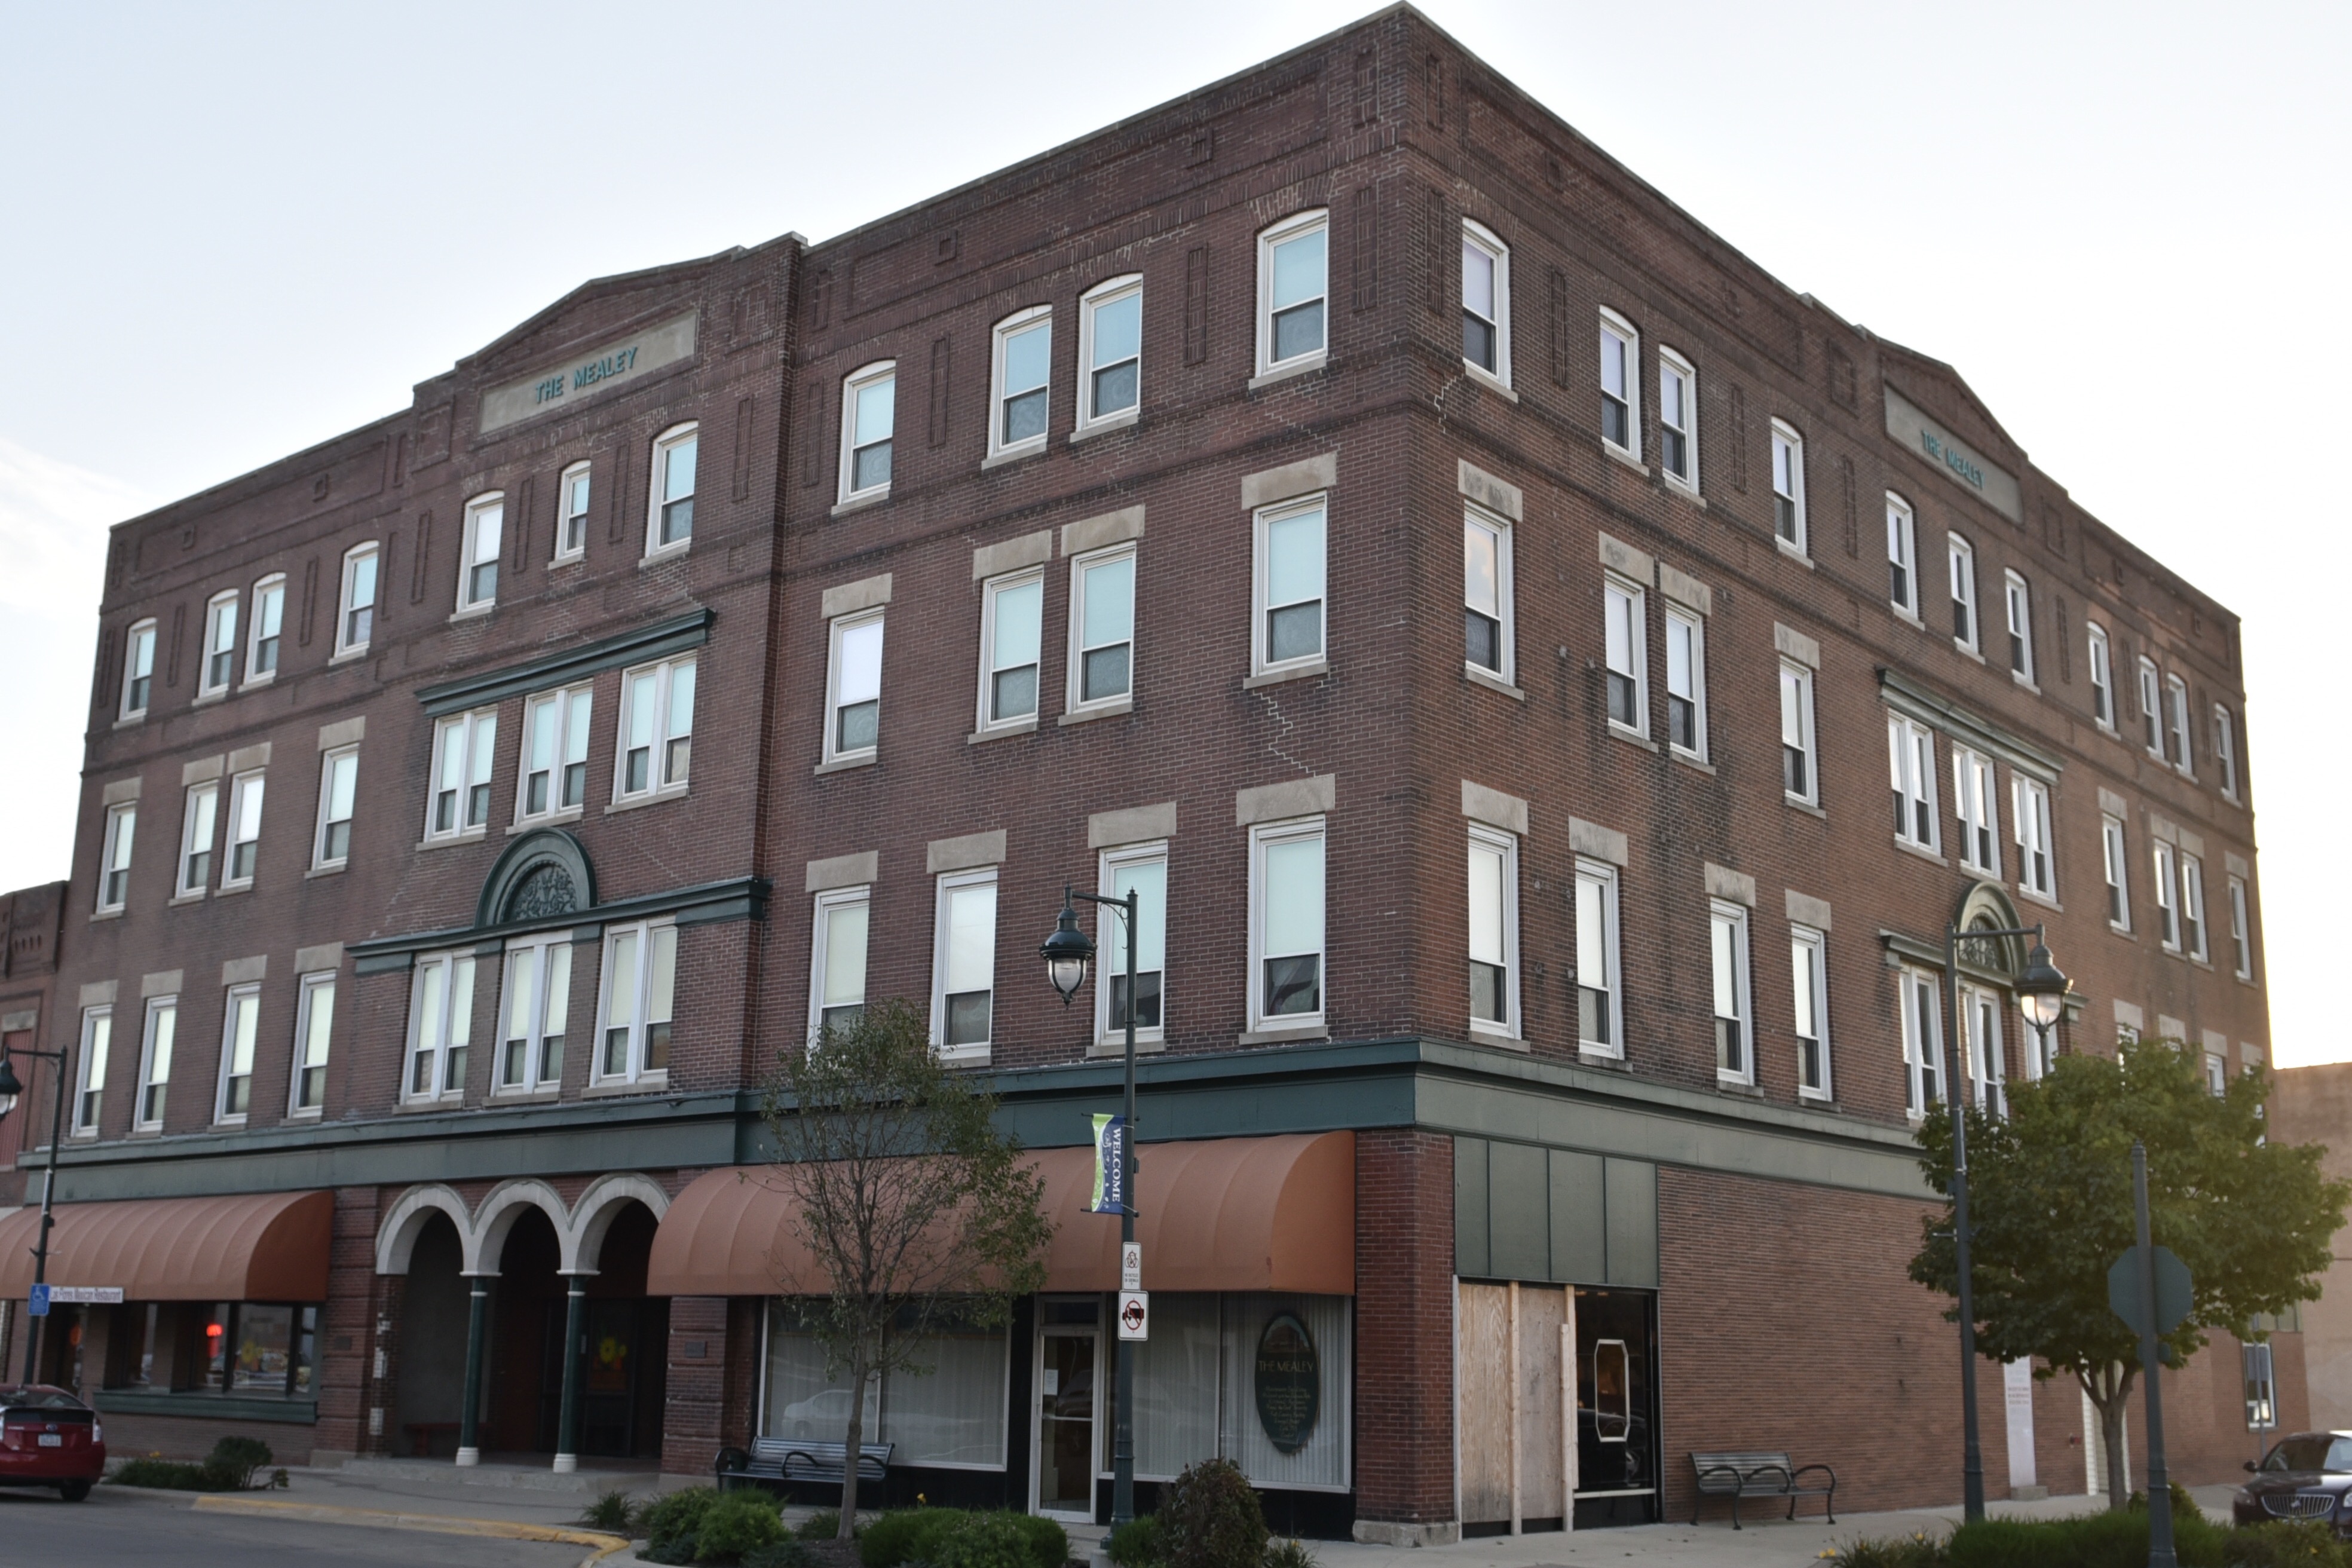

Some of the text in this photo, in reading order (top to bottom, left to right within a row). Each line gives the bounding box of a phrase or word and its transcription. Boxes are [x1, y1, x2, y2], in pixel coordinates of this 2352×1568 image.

[536, 347, 639, 404] THE MEALEY
[1921, 429, 1986, 491] THE MEALEY
[1112, 1127, 1122, 1202] WELCOME
[1258, 1361, 1314, 1373] THE MEALEY
